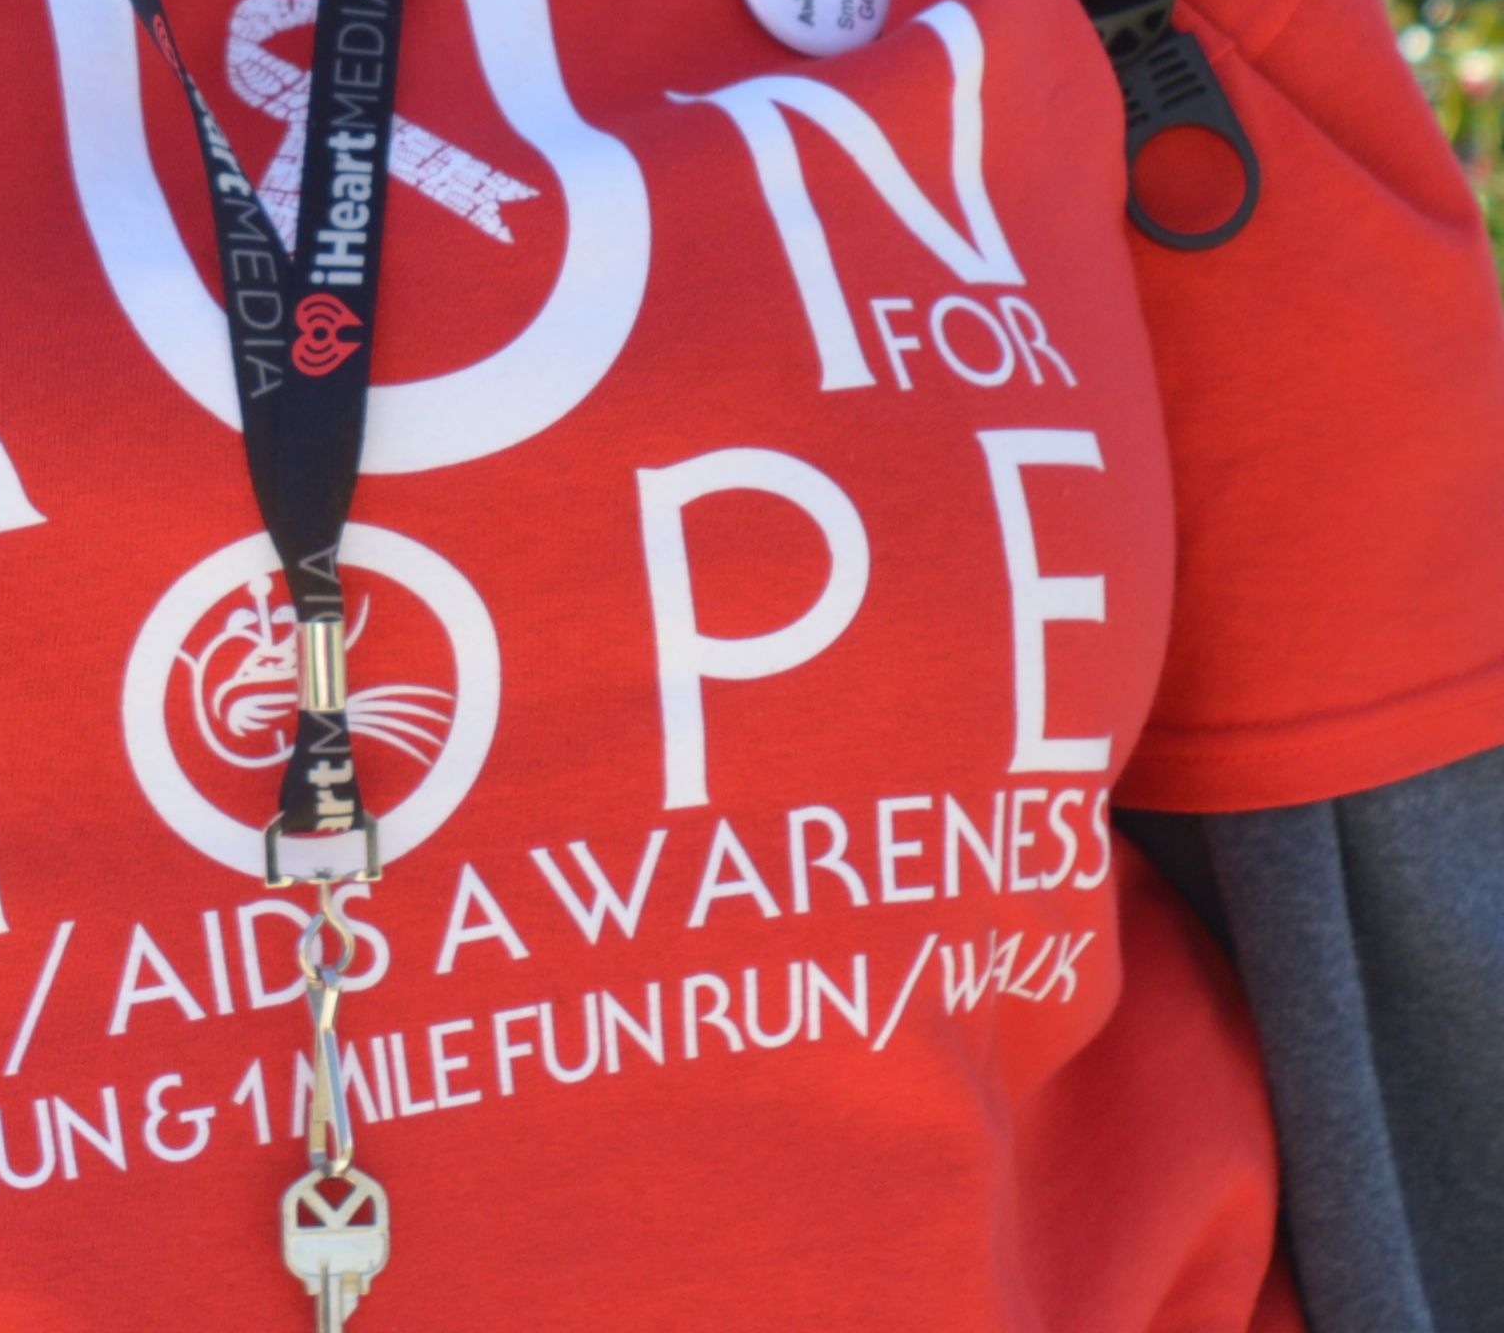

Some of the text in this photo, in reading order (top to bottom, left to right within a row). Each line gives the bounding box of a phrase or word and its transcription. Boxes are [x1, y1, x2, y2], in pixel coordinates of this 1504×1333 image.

[870, 294, 1079, 391] FOR
[435, 786, 1113, 976] AWARENESS
[143, 1073, 216, 1162] &
[232, 1057, 271, 1145] 1
[291, 1018, 483, 1139] MILE
[492, 982, 666, 1096] FUN
